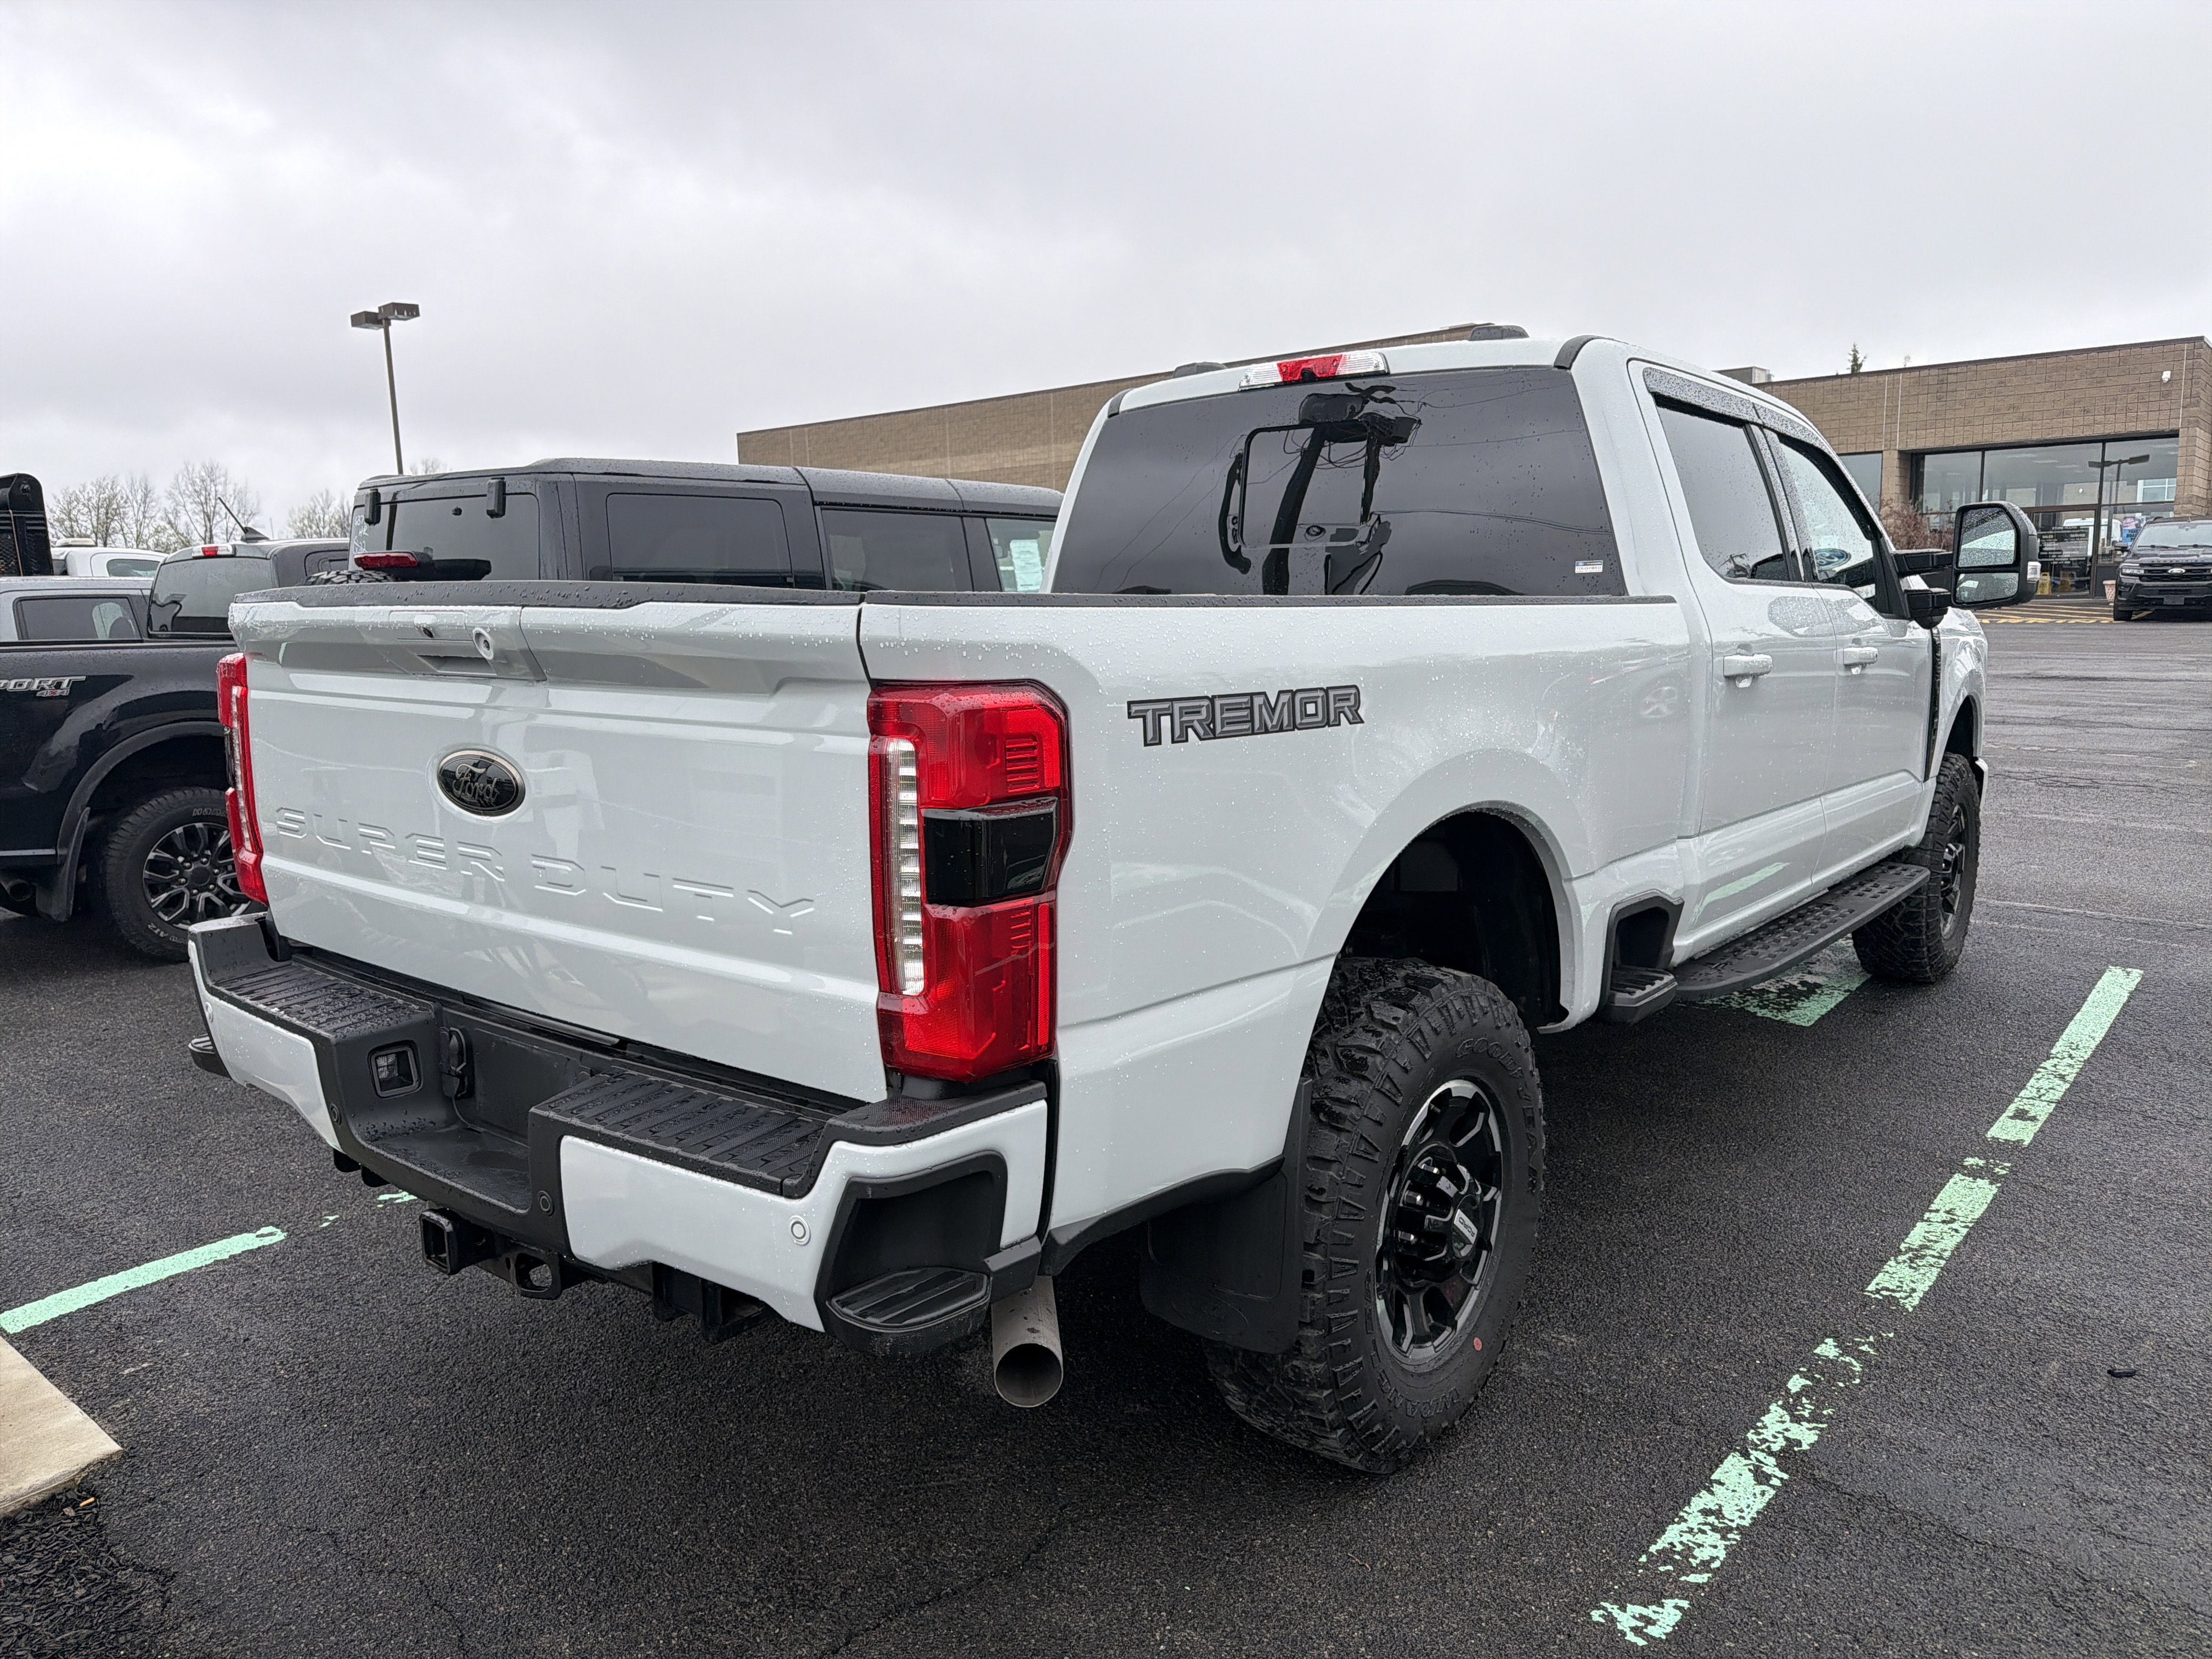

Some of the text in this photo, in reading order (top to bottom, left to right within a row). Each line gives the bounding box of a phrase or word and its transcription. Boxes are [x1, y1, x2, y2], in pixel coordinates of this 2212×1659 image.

[1127, 684, 1365, 747] TREMOR
[452, 763, 499, 802] Ford
[275, 807, 814, 934] SUPER DUTY
[1455, 1037, 1538, 1193] GOODYEAR
[1458, 1216, 1475, 1238] FORD
